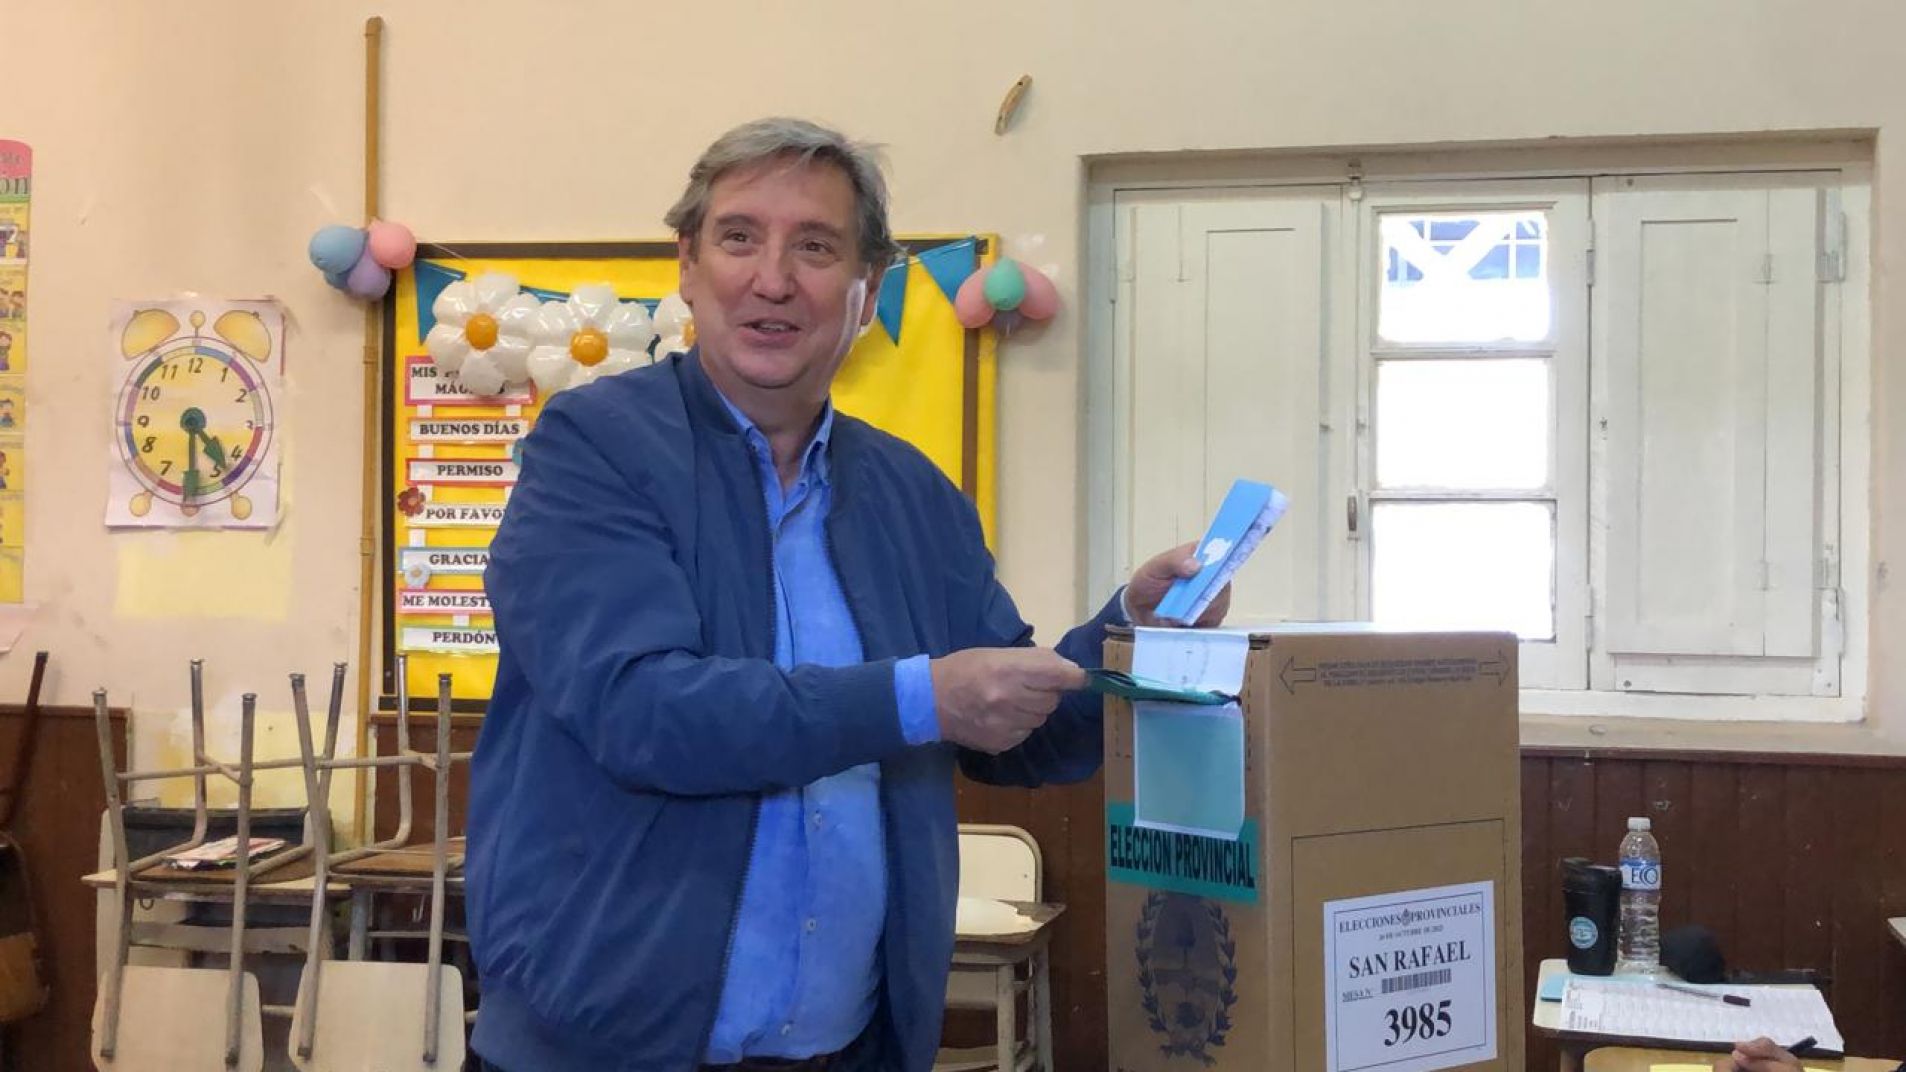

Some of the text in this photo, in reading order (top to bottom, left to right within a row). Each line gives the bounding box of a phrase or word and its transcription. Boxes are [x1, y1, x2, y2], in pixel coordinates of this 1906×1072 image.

[161, 364, 178, 379] 11
[188, 357, 203, 373] 12
[412, 367, 438, 378] MIS
[221, 367, 228, 382] 1
[142, 386, 160, 400] 10
[235, 389, 247, 402] 2
[137, 415, 150, 428] 9
[419, 421, 520, 435] BUENOS DÍAS
[142, 436, 157, 453] 8
[231, 445, 242, 461] 4
[160, 460, 172, 476] 7
[437, 465, 503, 476] PERMISO
[426, 508, 503, 520] POR FAVO
[429, 554, 488, 566] GRACIA
[403, 595, 490, 607] ME MOLEST
[432, 629, 496, 644] PERDÓN
[1110, 823, 1255, 888] ELECCION PROVINCIAL
[1631, 867, 1658, 885] ECO
[1339, 902, 1481, 933] ELECCIONES PROVINCIALES
[1349, 940, 1471, 979] SAN RAFAEL
[1384, 1000, 1453, 1047] 3985
